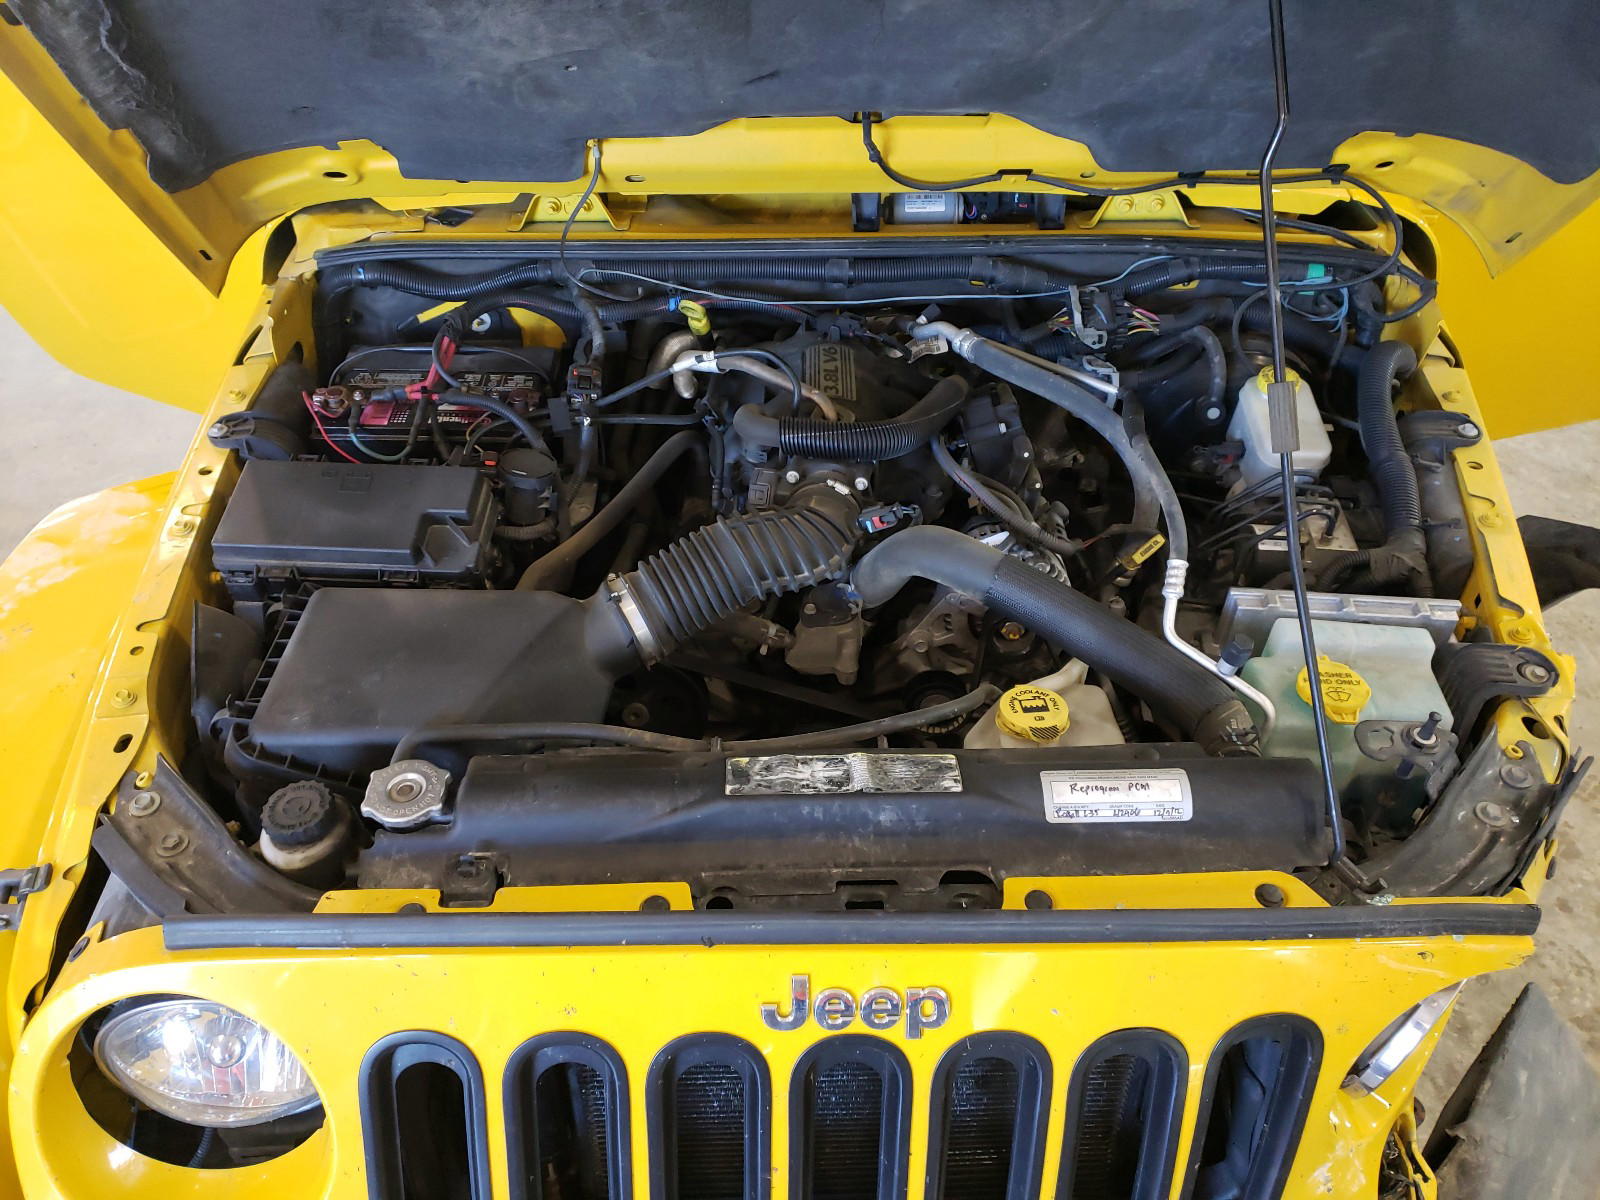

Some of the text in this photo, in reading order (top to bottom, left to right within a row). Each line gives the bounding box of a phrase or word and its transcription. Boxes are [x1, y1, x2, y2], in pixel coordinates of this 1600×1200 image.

[823, 346, 838, 363] V6
[1335, 678, 1361, 686] ONLY
[1015, 689, 1050, 697] COOLANT
[1049, 697, 1061, 711] ONLY
[760, 973, 950, 1039] Jeep
